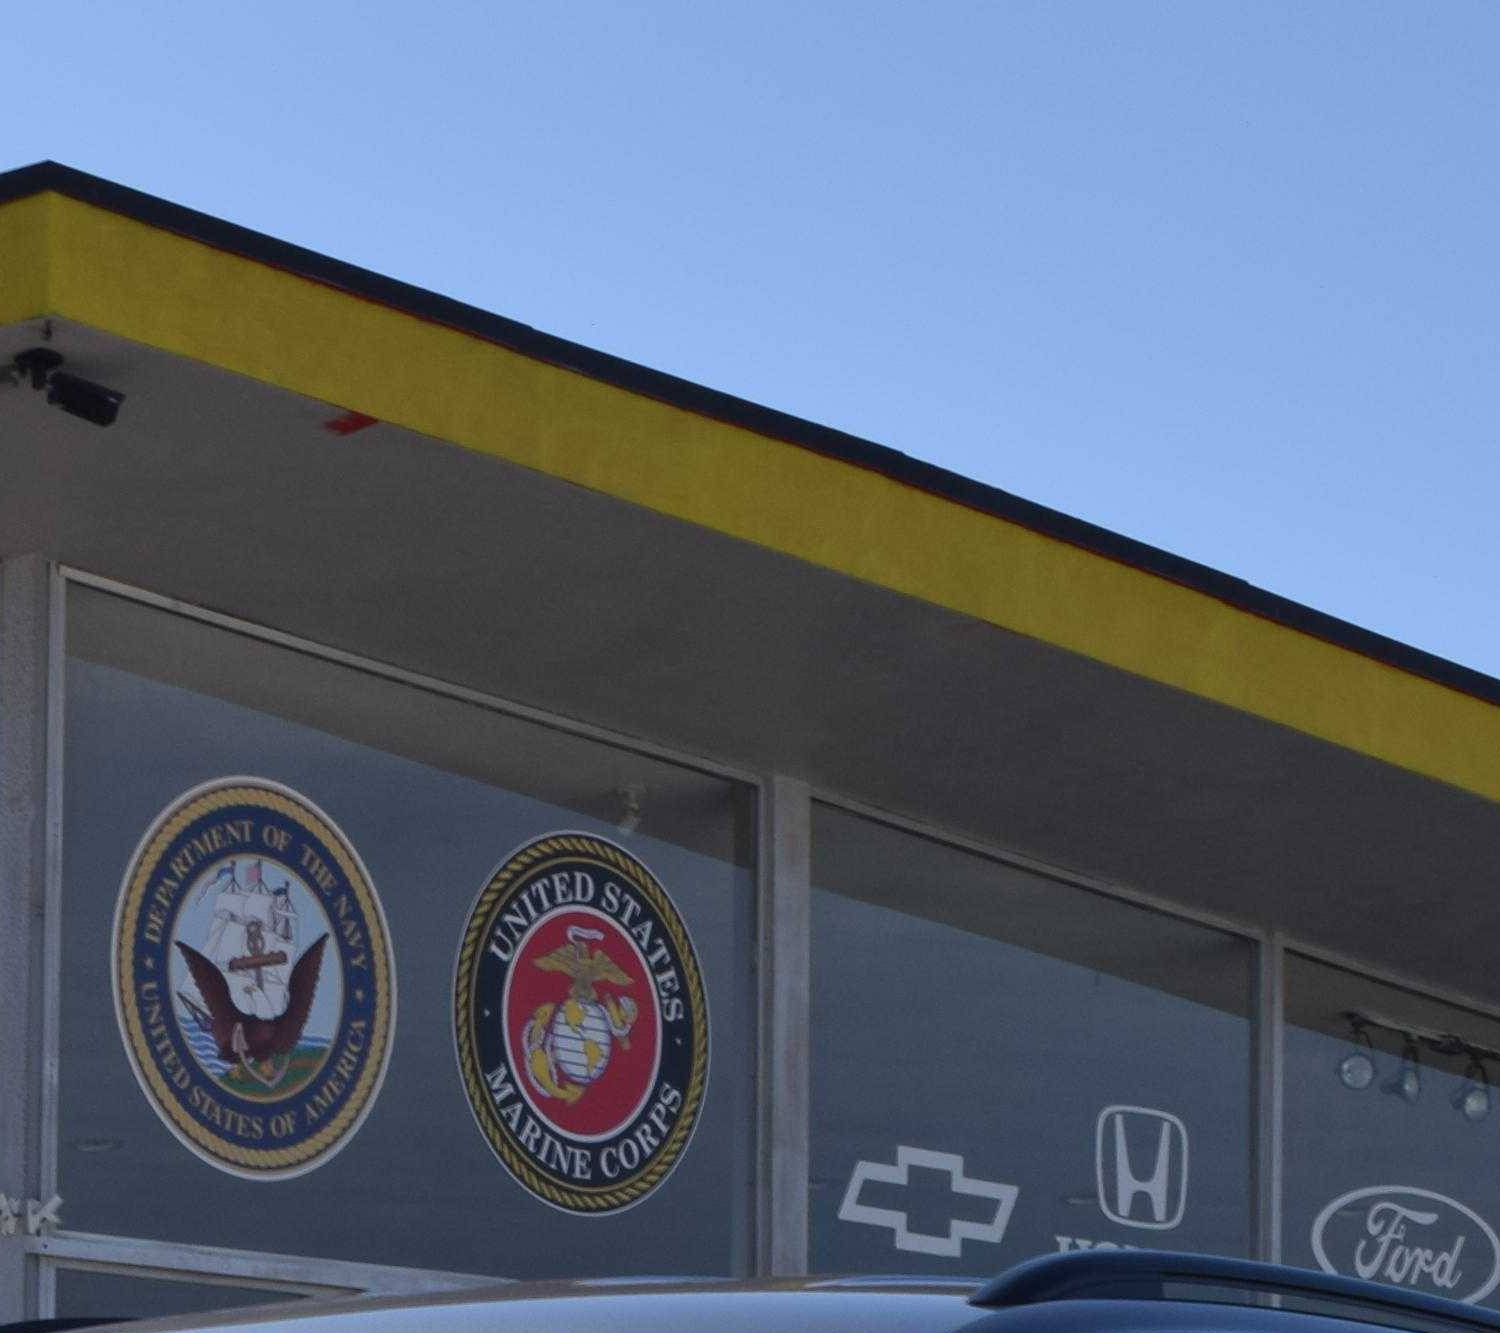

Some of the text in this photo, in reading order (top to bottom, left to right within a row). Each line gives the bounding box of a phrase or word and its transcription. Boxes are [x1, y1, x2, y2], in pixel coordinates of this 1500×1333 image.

[145, 821, 369, 969] DEPARTMENT OF THE NAVY
[488, 871, 685, 1023] UNITED STATES
[141, 982, 366, 1139] UNITED STATES OF AMERICA
[486, 1065, 682, 1180] MARINE CORPS
[1355, 1202, 1467, 1289] Ford
